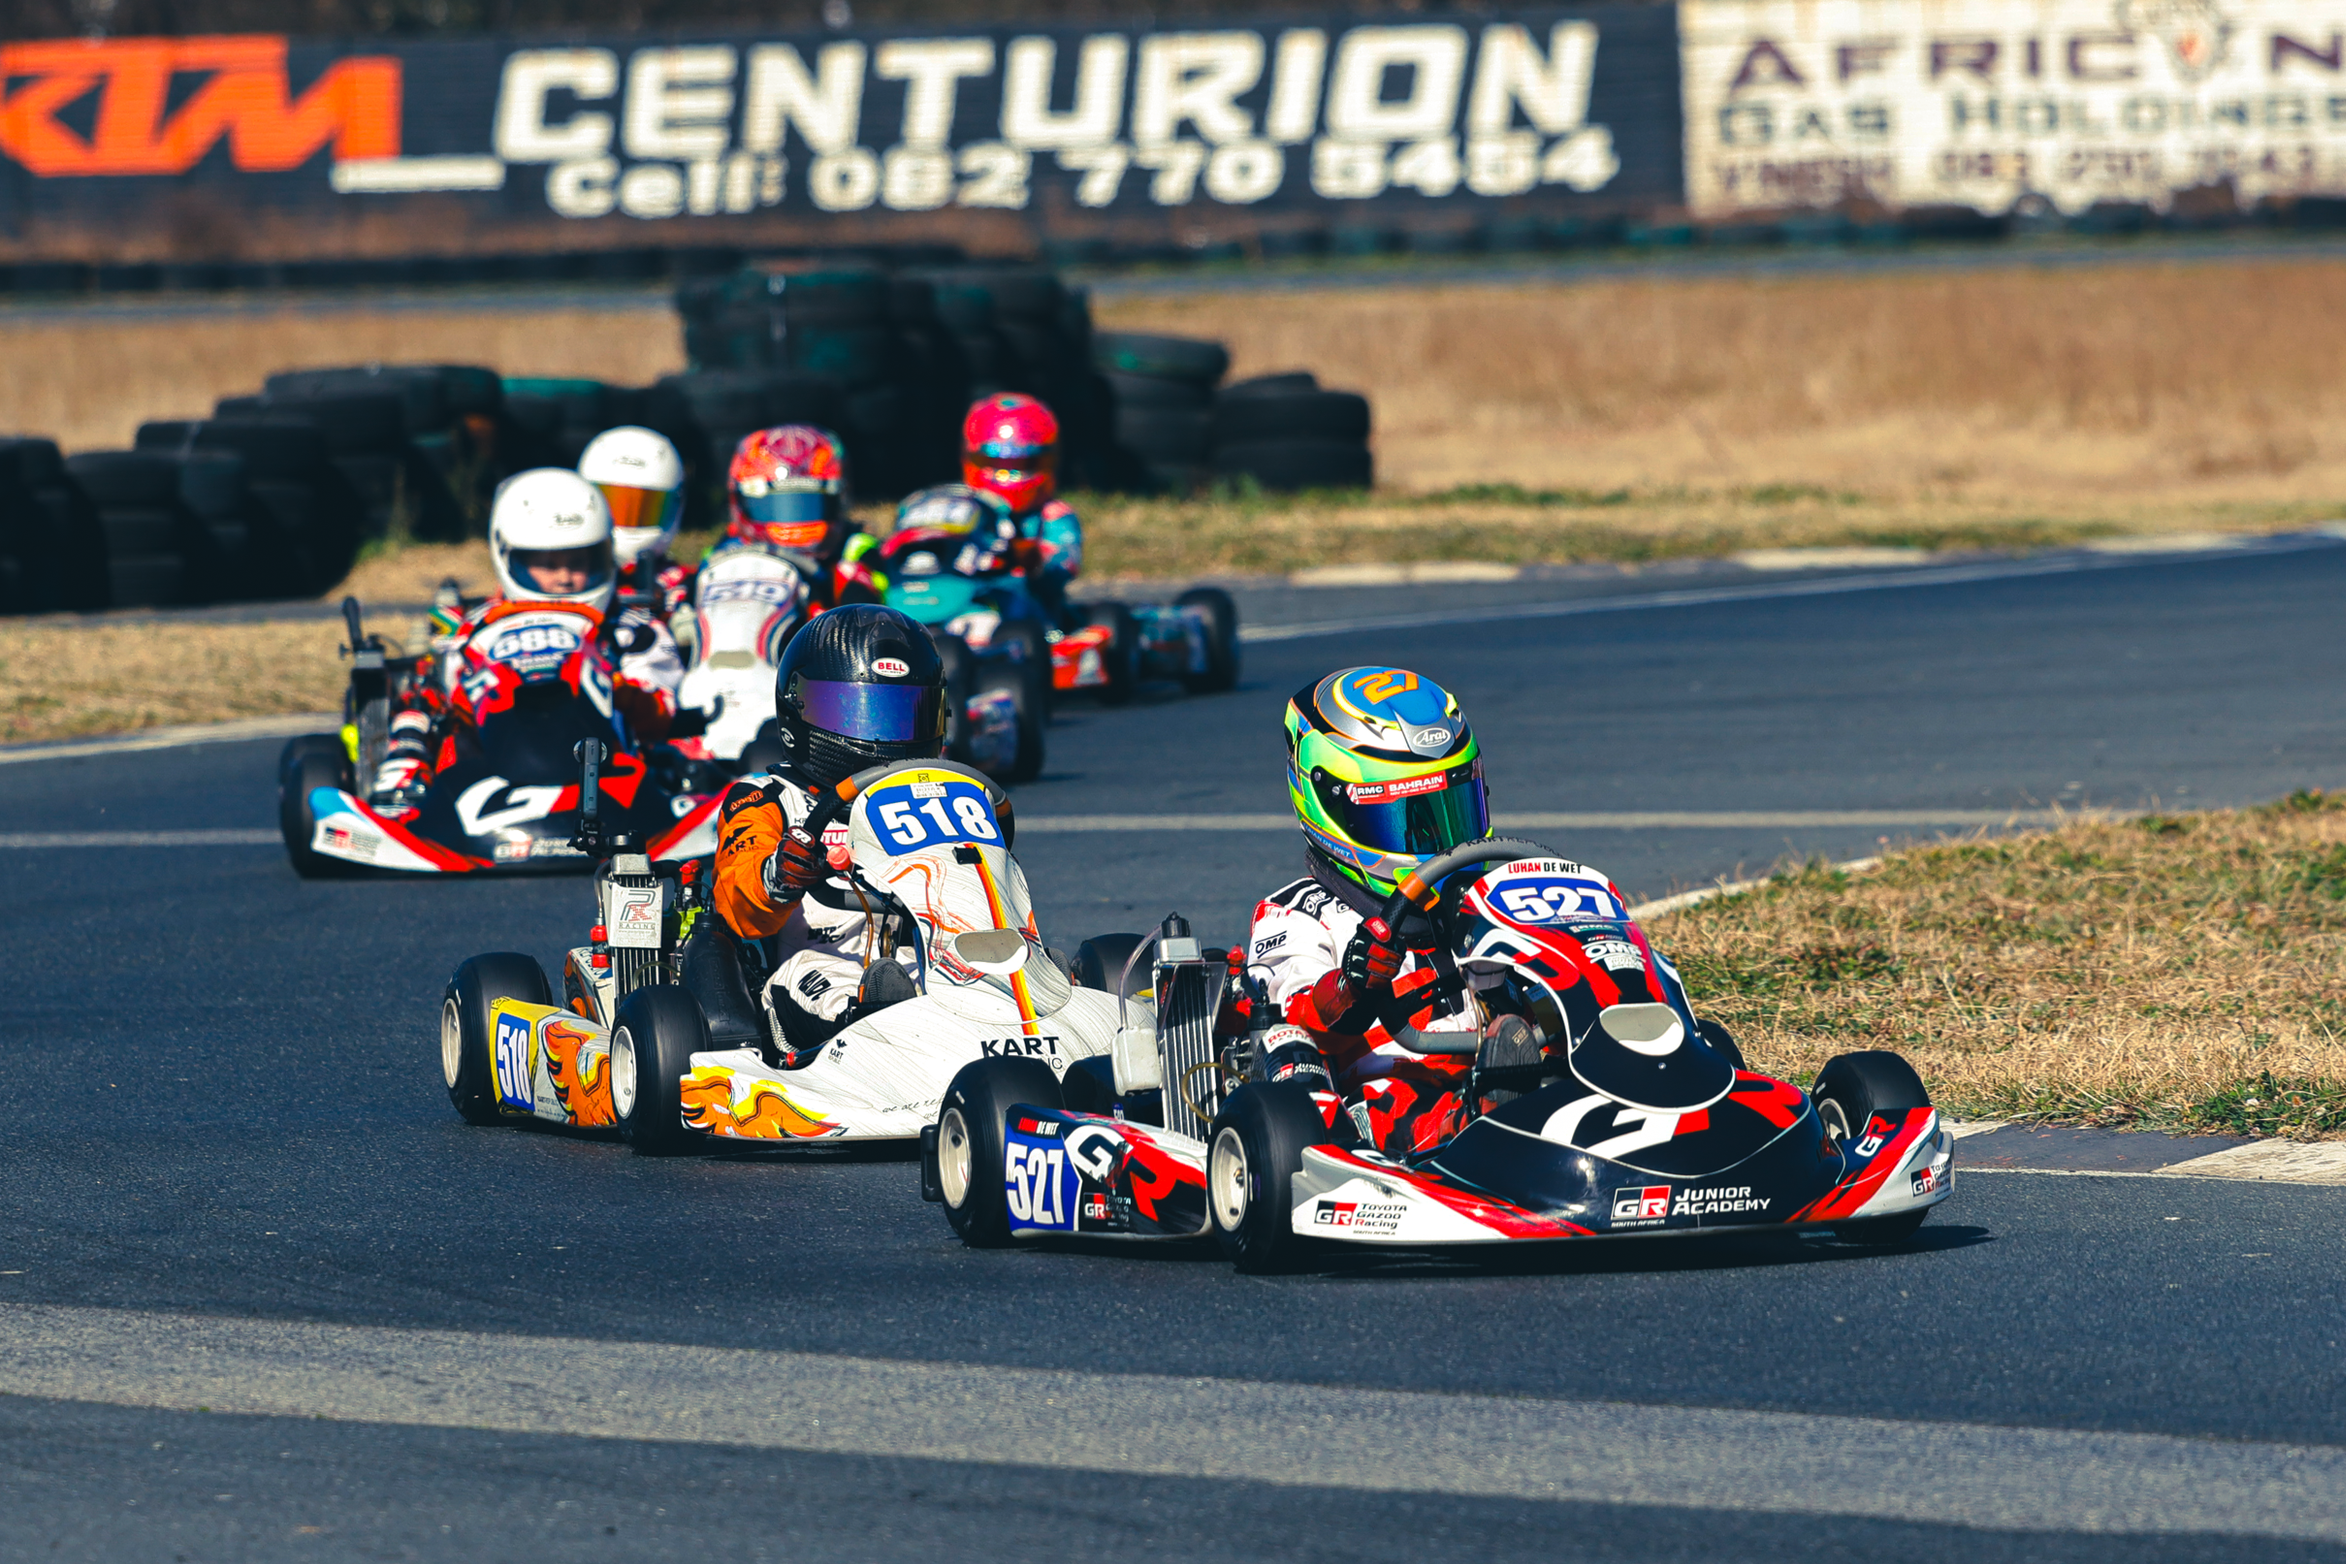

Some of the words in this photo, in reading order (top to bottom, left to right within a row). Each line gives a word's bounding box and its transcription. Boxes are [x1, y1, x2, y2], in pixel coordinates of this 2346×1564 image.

[1728, 30, 2342, 94] AFRICN
[494, 20, 1600, 165] CENTURION
[0, 34, 401, 177] KTM
[1719, 98, 1896, 148] GAS
[1055, 138, 1284, 208] 770
[1309, 124, 1621, 201] 5454
[877, 662, 906, 672] BELL
[1353, 669, 1419, 705] 27
[1417, 730, 1447, 745] Arai
[1357, 785, 1384, 796] RMC
[1388, 775, 1444, 792] BAHRAIN
[877, 796, 998, 846] 518
[1507, 862, 1542, 874] LUHAN
[1543, 862, 1557, 873] DE
[1559, 863, 1582, 874] WET
[1500, 886, 1617, 921] 527
[618, 922, 656, 930] RACING
[1255, 934, 1287, 955] OMP
[1585, 942, 1643, 959] OMP
[829, 1048, 844, 1060] KART
[980, 1036, 1060, 1058] KART
[497, 1022, 532, 1105] 518
[1855, 1115, 1897, 1157] GR
[1005, 1141, 1065, 1225] 527
[1912, 1176, 1934, 1196] GR
[1674, 1186, 1752, 1203] JUNIOR
[1085, 1203, 1106, 1218] GR
[1356, 1211, 1402, 1220] GAZOO
[1361, 1203, 1408, 1212] TOYOTA
[1613, 1198, 1667, 1218] GR
[1671, 1198, 1771, 1217] ACADEMY
[1315, 1209, 1353, 1226] GR
[1355, 1219, 1398, 1230] Racing
